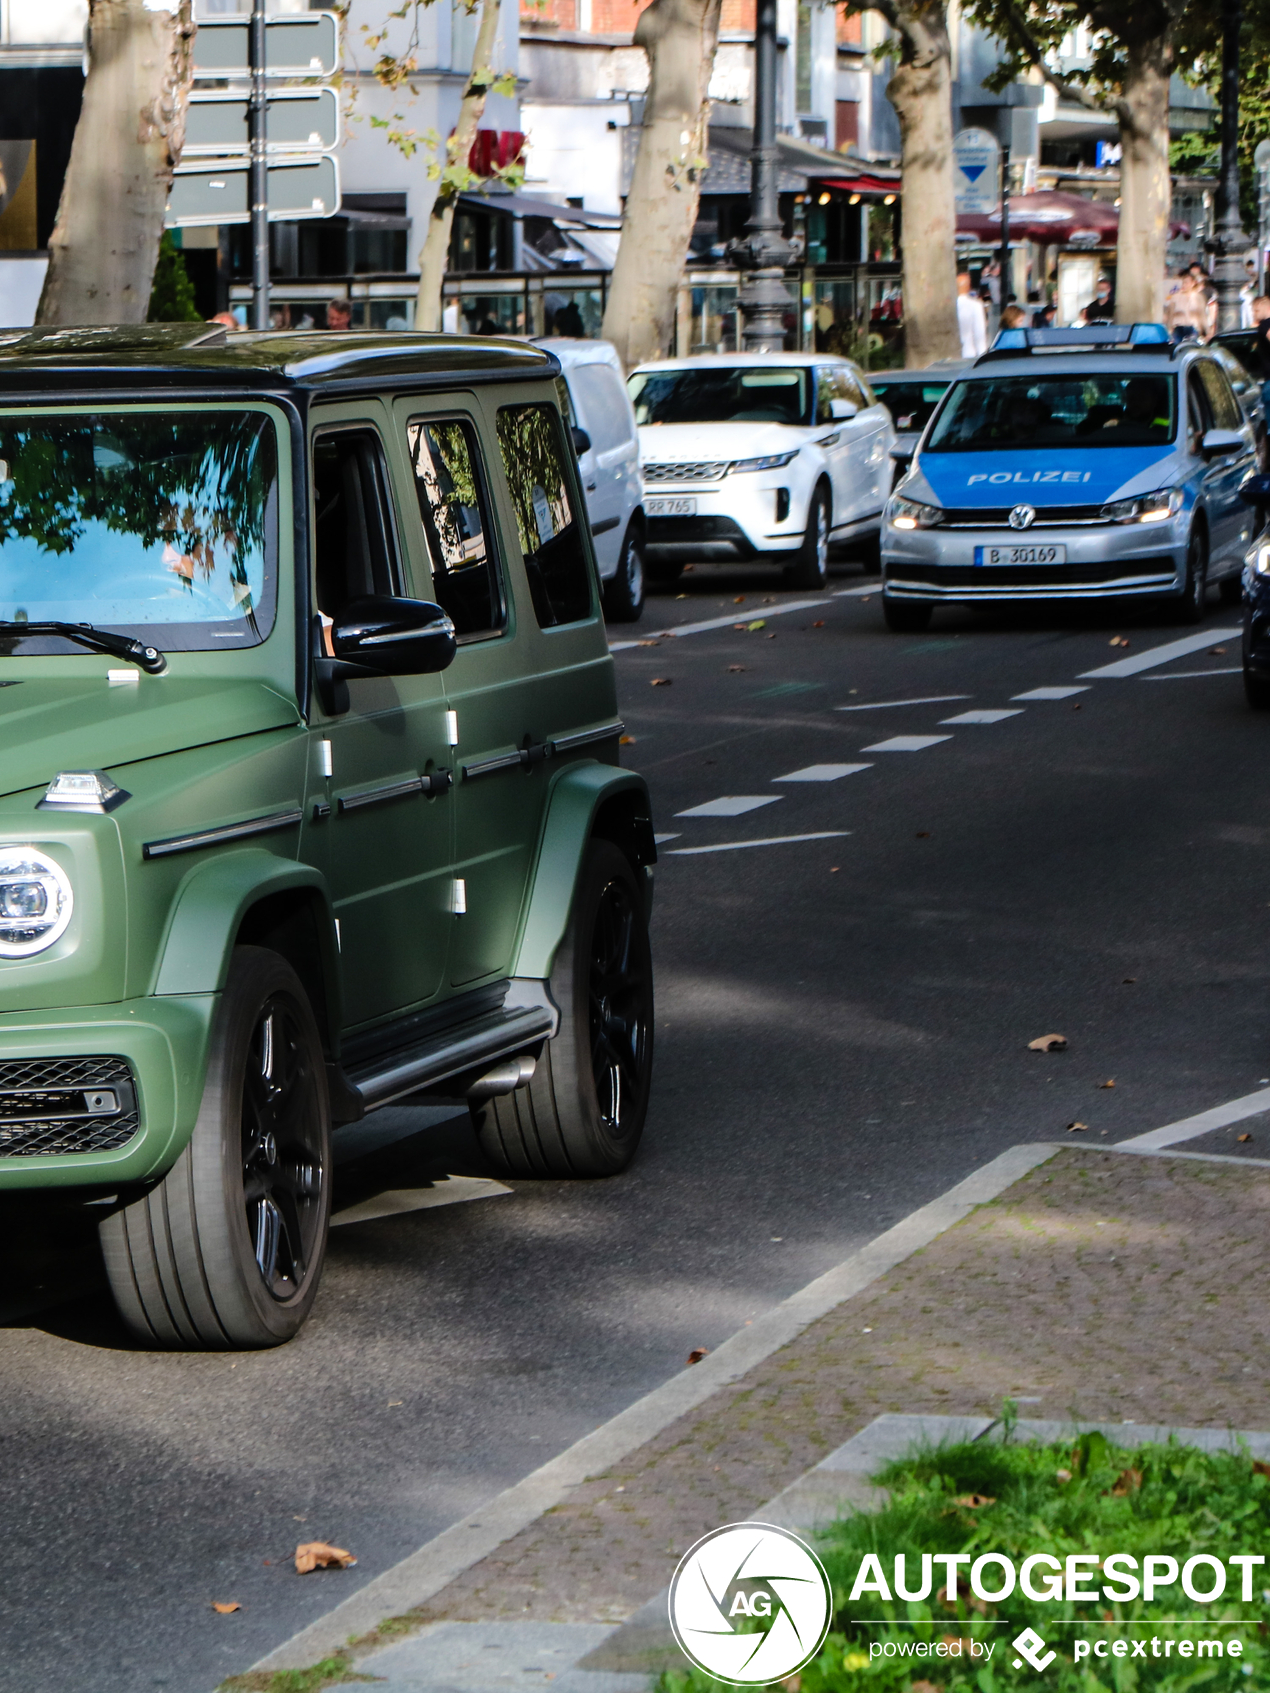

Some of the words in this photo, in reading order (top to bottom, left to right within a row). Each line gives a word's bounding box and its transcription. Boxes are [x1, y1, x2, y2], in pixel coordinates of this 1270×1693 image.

[967, 471, 1092, 486] POLIZEI
[667, 501, 690, 513] 765
[990, 549, 1000, 564] B
[1010, 547, 1056, 563] 30169
